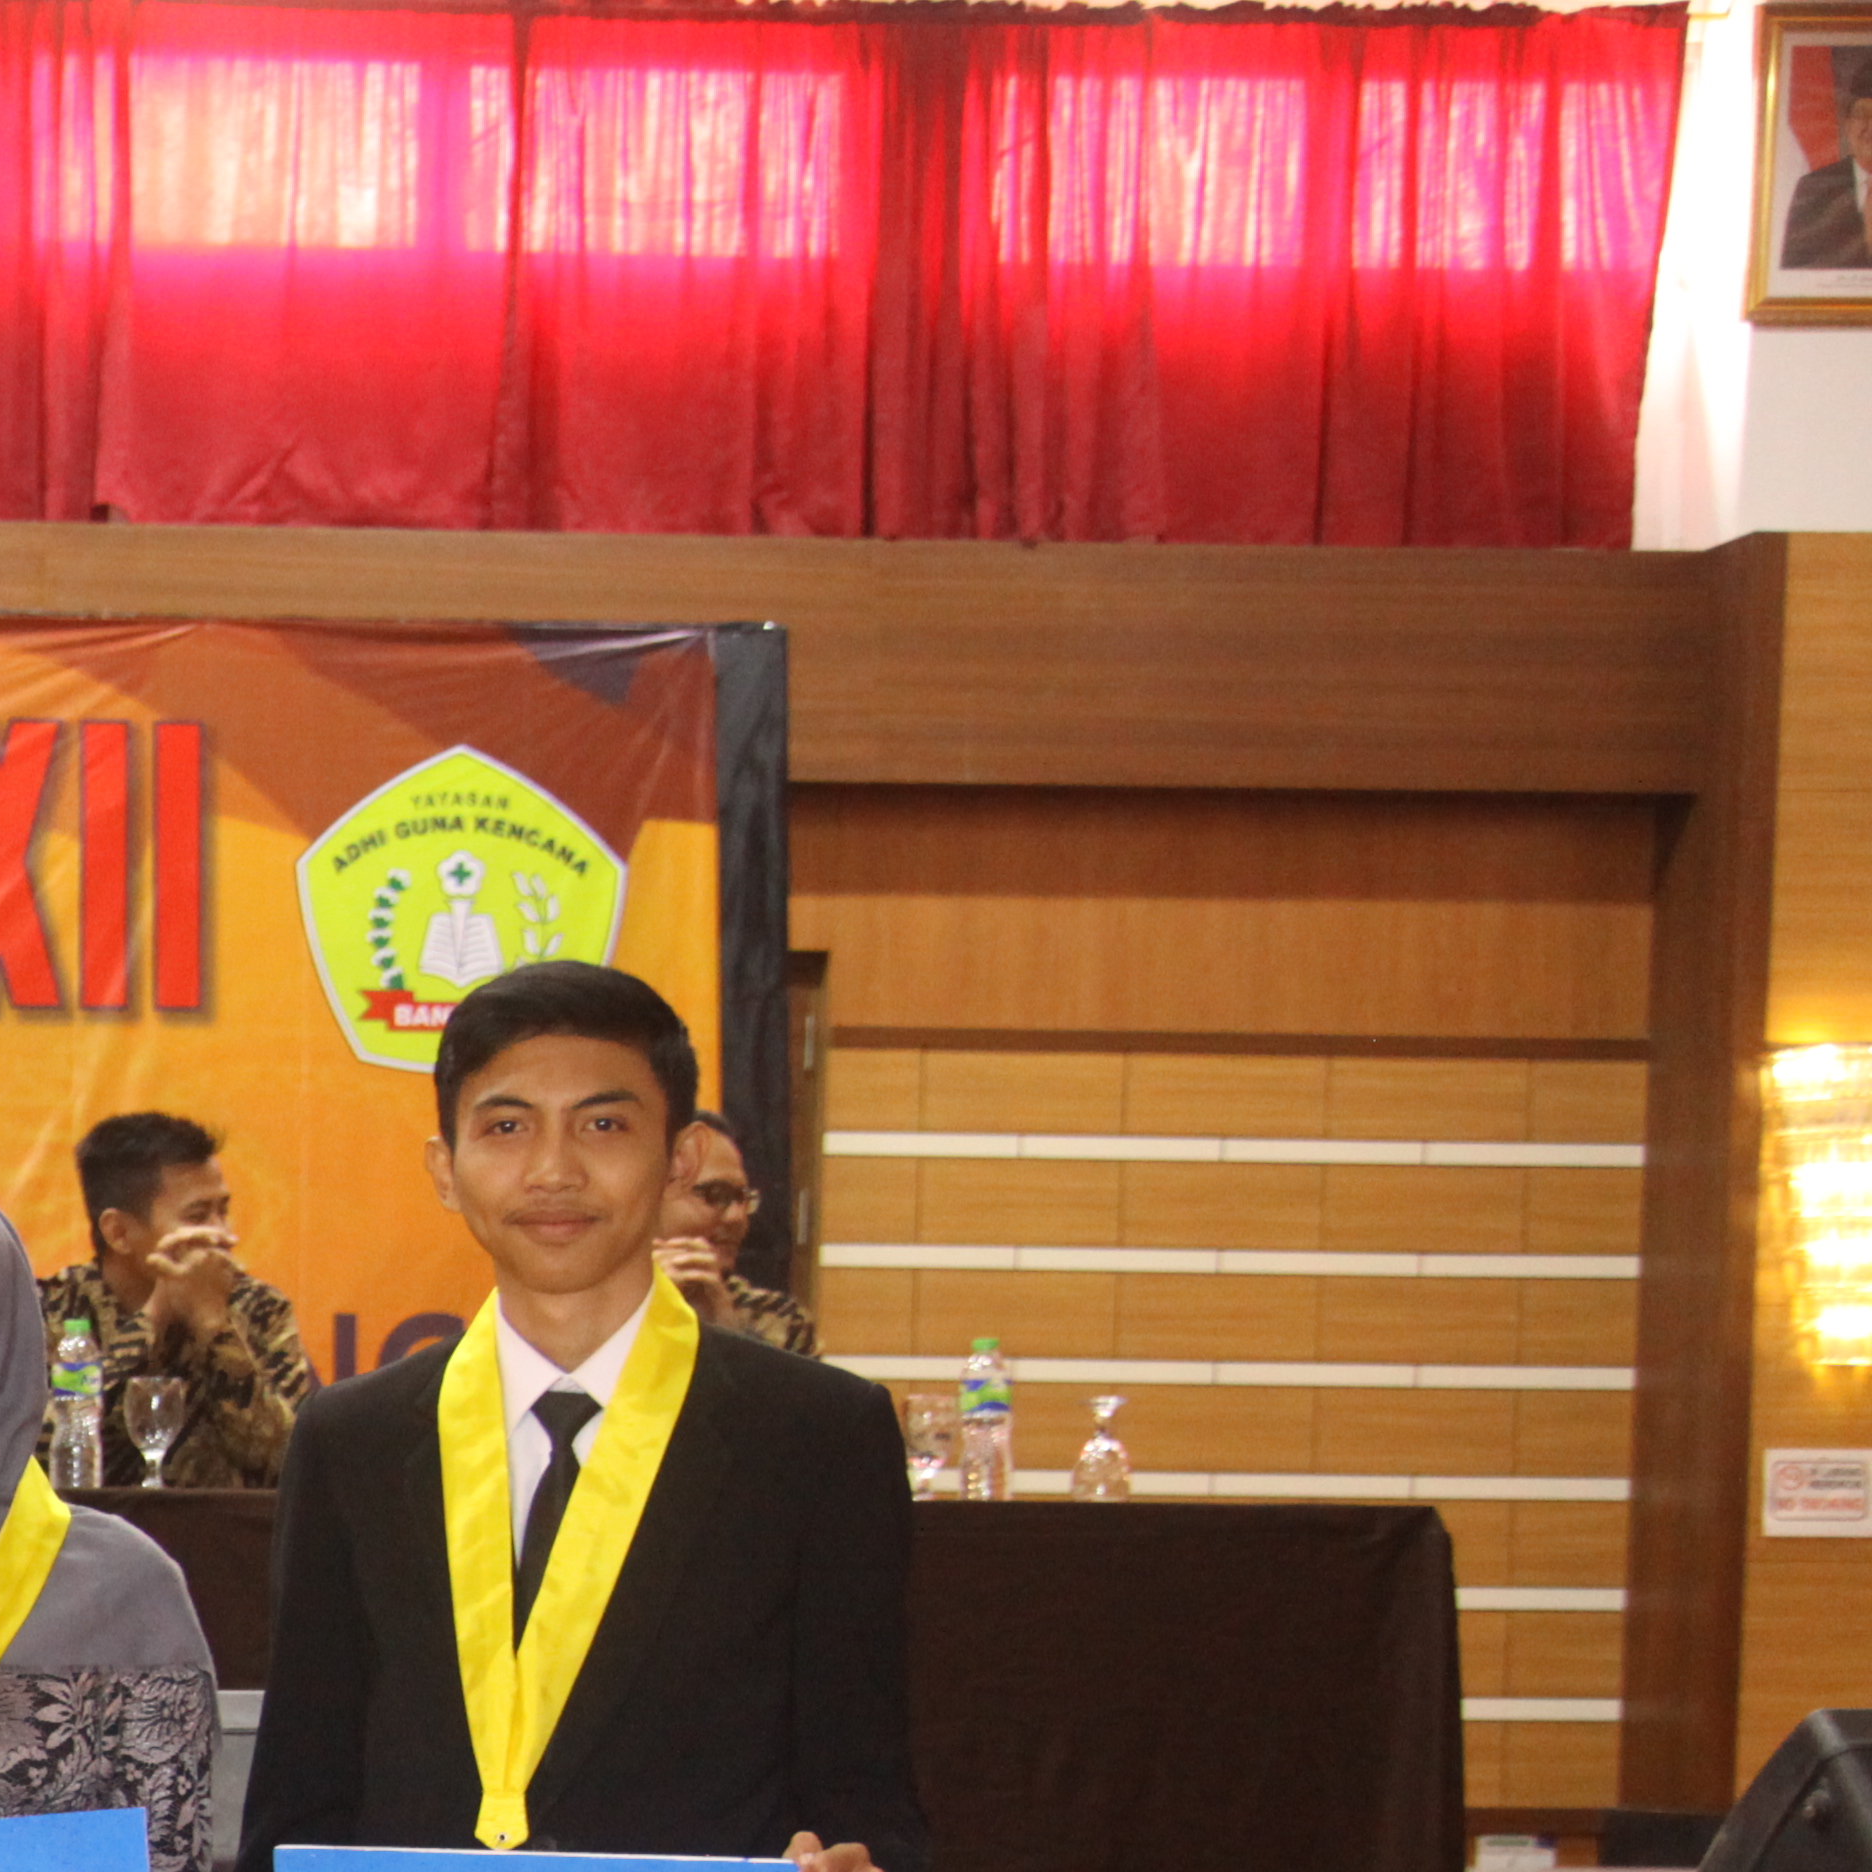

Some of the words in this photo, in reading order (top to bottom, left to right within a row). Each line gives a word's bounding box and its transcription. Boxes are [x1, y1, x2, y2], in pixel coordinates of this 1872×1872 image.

[411, 791, 512, 810] YAYASAN
[332, 829, 389, 874] ADHI
[395, 816, 464, 840] GUNA
[473, 816, 590, 876] KENCANA
